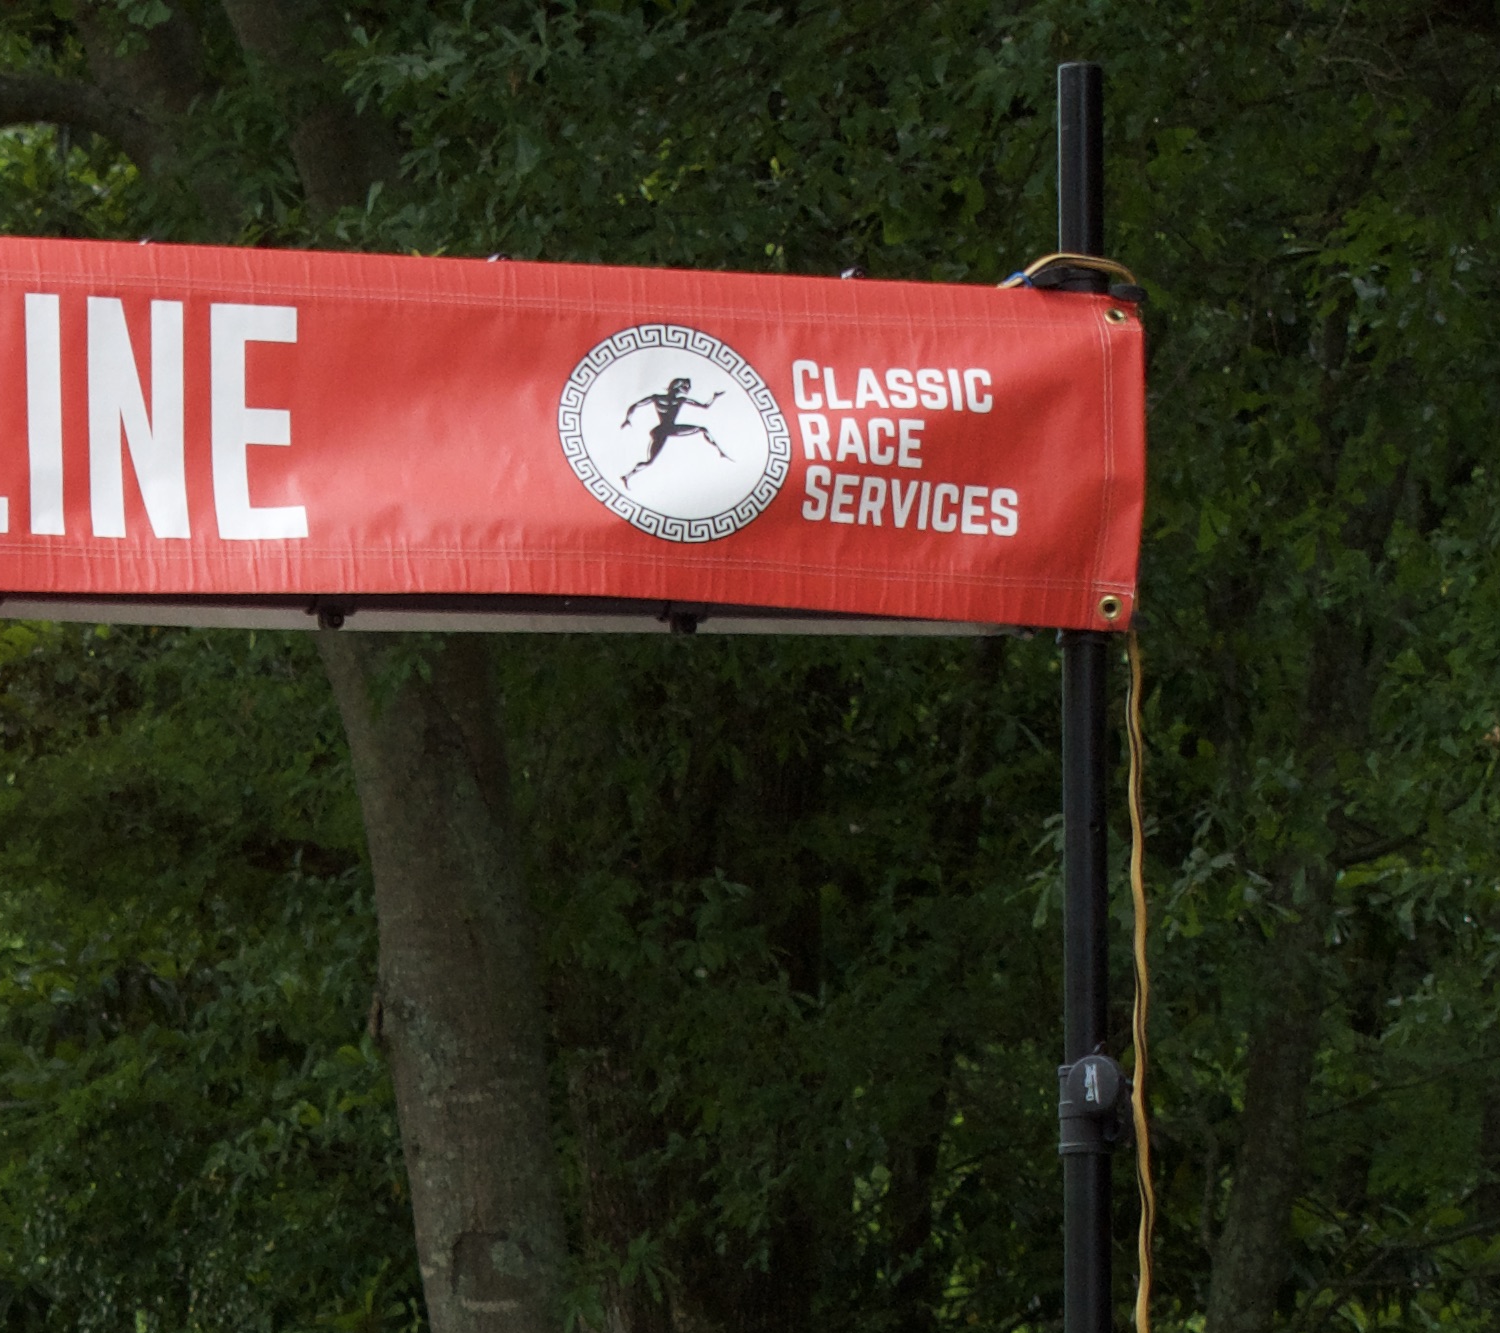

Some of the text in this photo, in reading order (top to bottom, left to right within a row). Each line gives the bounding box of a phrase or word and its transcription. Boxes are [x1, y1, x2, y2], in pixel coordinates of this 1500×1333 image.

[792, 359, 993, 413] CLASSIC
[798, 414, 925, 468] RACE
[802, 465, 1018, 536] SERVICES
